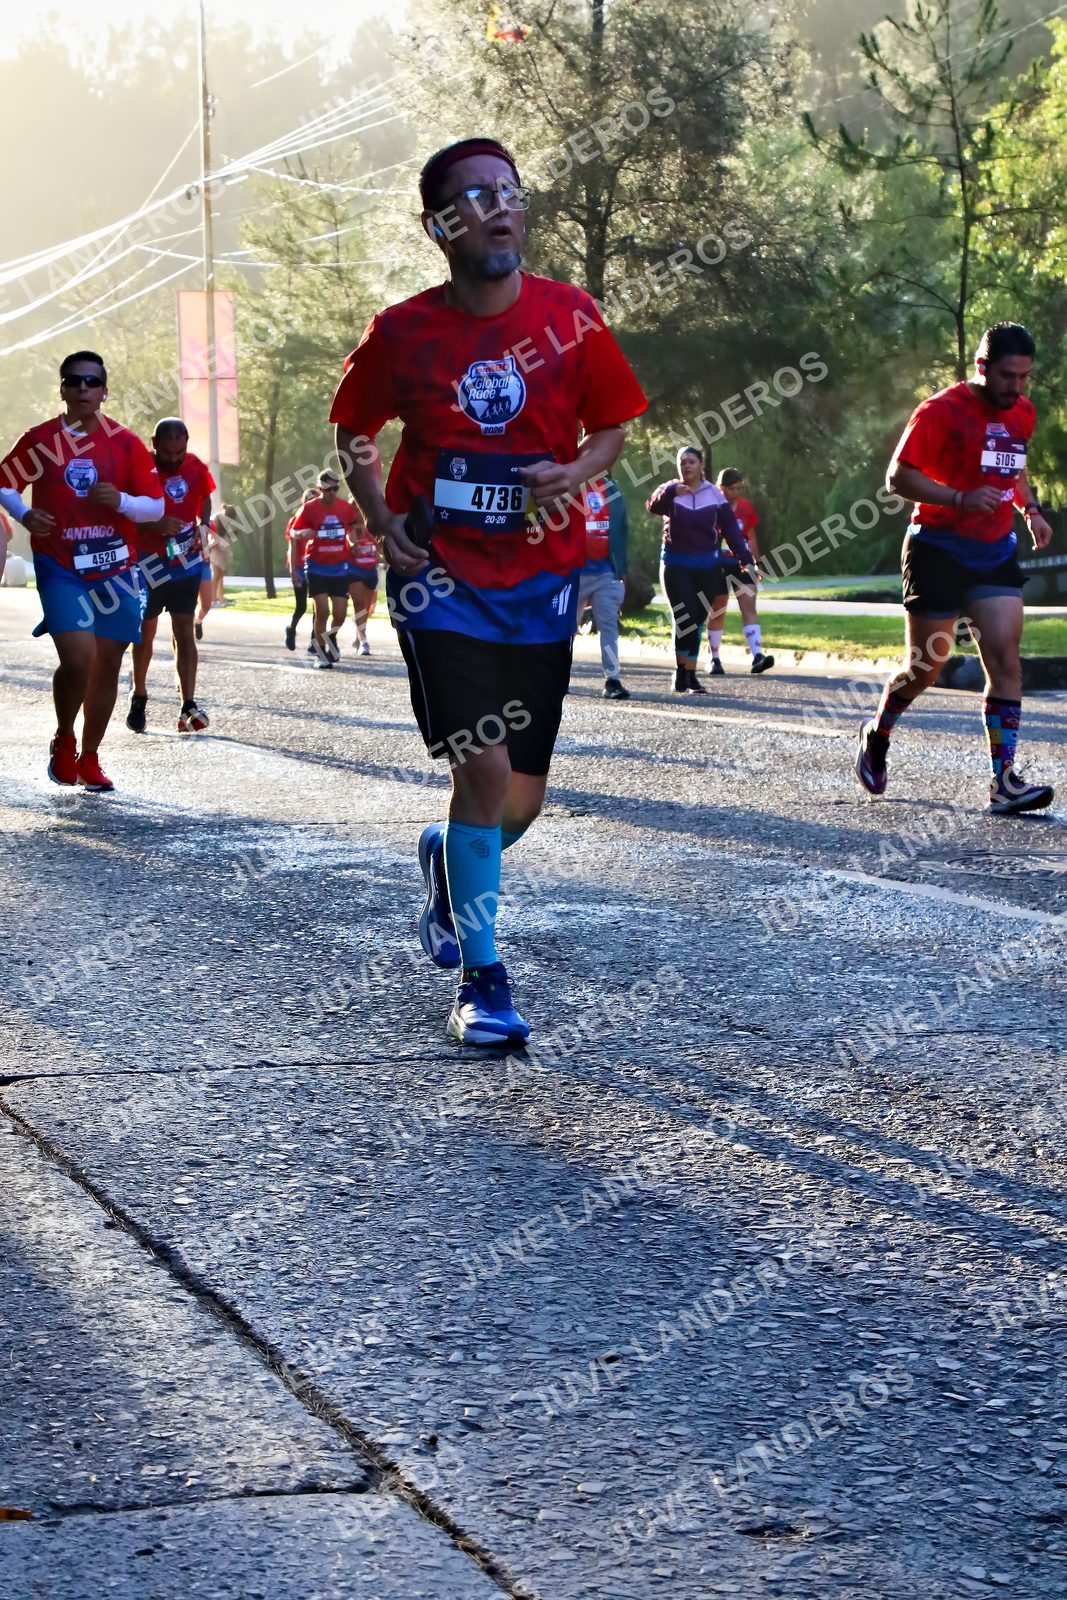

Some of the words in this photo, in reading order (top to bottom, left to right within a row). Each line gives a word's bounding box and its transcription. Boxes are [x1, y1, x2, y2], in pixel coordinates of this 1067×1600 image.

[475, 377, 509, 389] Global
[469, 389, 496, 400] Race
[996, 453, 1016, 467] 5105
[471, 485, 522, 511] 4736
[485, 515, 506, 524] 20-26
[92, 551, 117, 565] 4520
